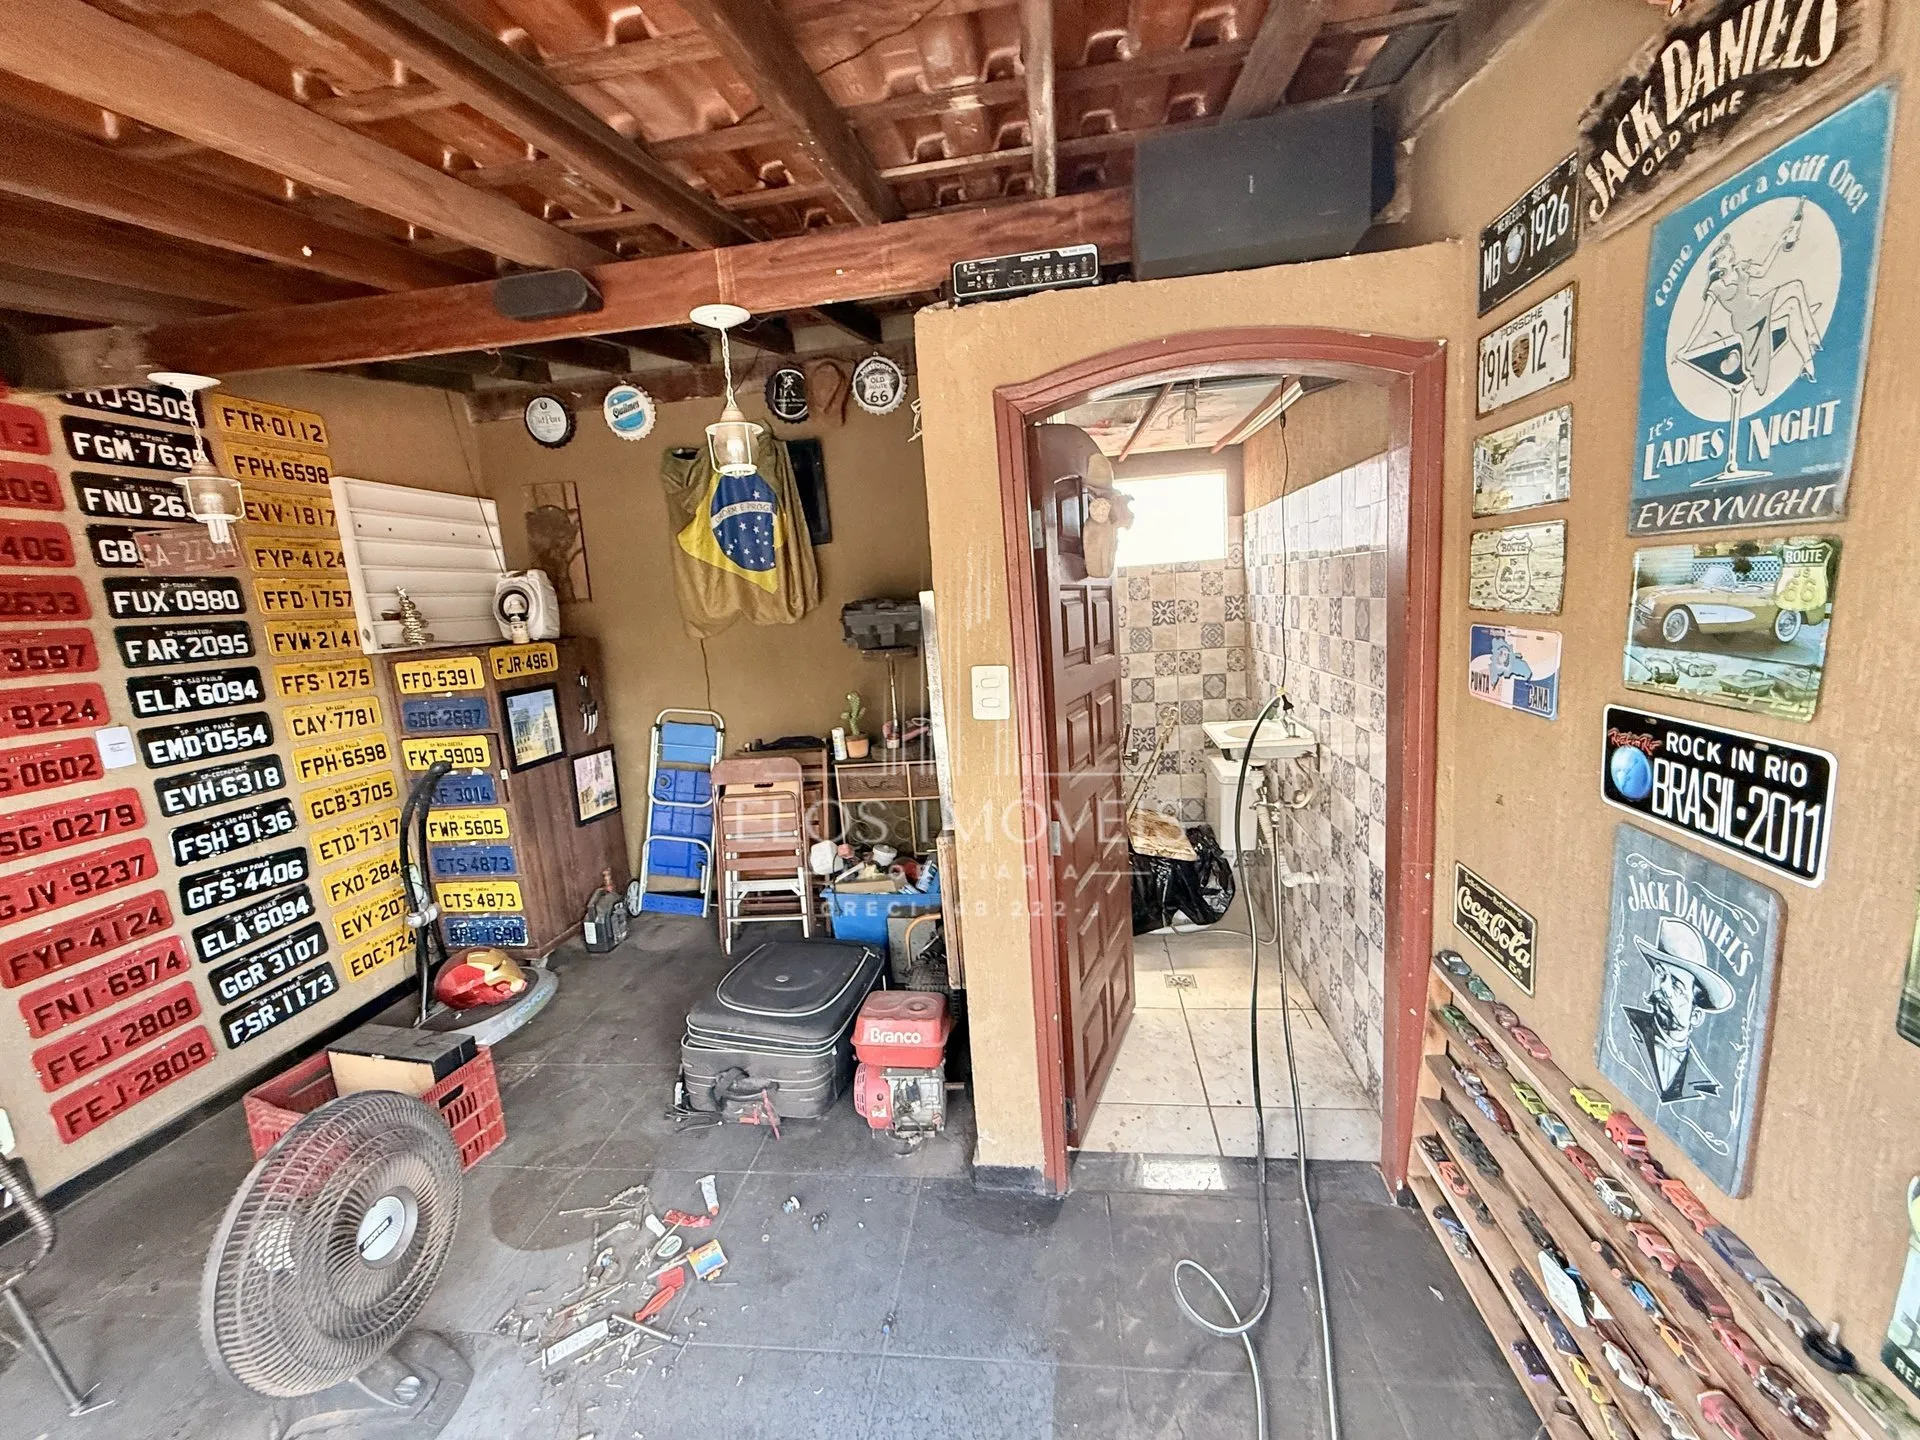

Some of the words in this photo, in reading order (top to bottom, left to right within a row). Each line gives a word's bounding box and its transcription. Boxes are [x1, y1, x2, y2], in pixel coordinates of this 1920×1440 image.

[1585, 86, 1664, 223] JACK
[1641, 130, 1682, 177] OLD
[1688, 90, 1745, 134] TIME
[1483, 241, 1501, 292] MB
[1530, 184, 1569, 257] 1926
[1655, 244, 1693, 307] Come
[1719, 184, 1751, 219] for
[1755, 175, 1769, 194] a
[1775, 154, 1829, 186] Stiff
[1828, 159, 1869, 215] One!
[1500, 306, 1543, 337] PORSCHE
[870, 391, 889, 403] 66
[1482, 340, 1509, 397] 1914
[1642, 428, 1725, 481] LADIES
[1748, 400, 1842, 463] NIGHT
[1785, 548, 1824, 564] ROUTE
[1783, 580, 1816, 603] 66
[1471, 671, 1490, 694] PUNTA
[1528, 684, 1550, 712] CANA
[1666, 731, 1722, 765] ROCK
[1731, 747, 1754, 774] IN
[1765, 755, 1808, 788] RIO
[1628, 875, 1672, 913] JACK
[1673, 880, 1753, 977] DANIEL'S
[870, 1027, 921, 1044] Branco
